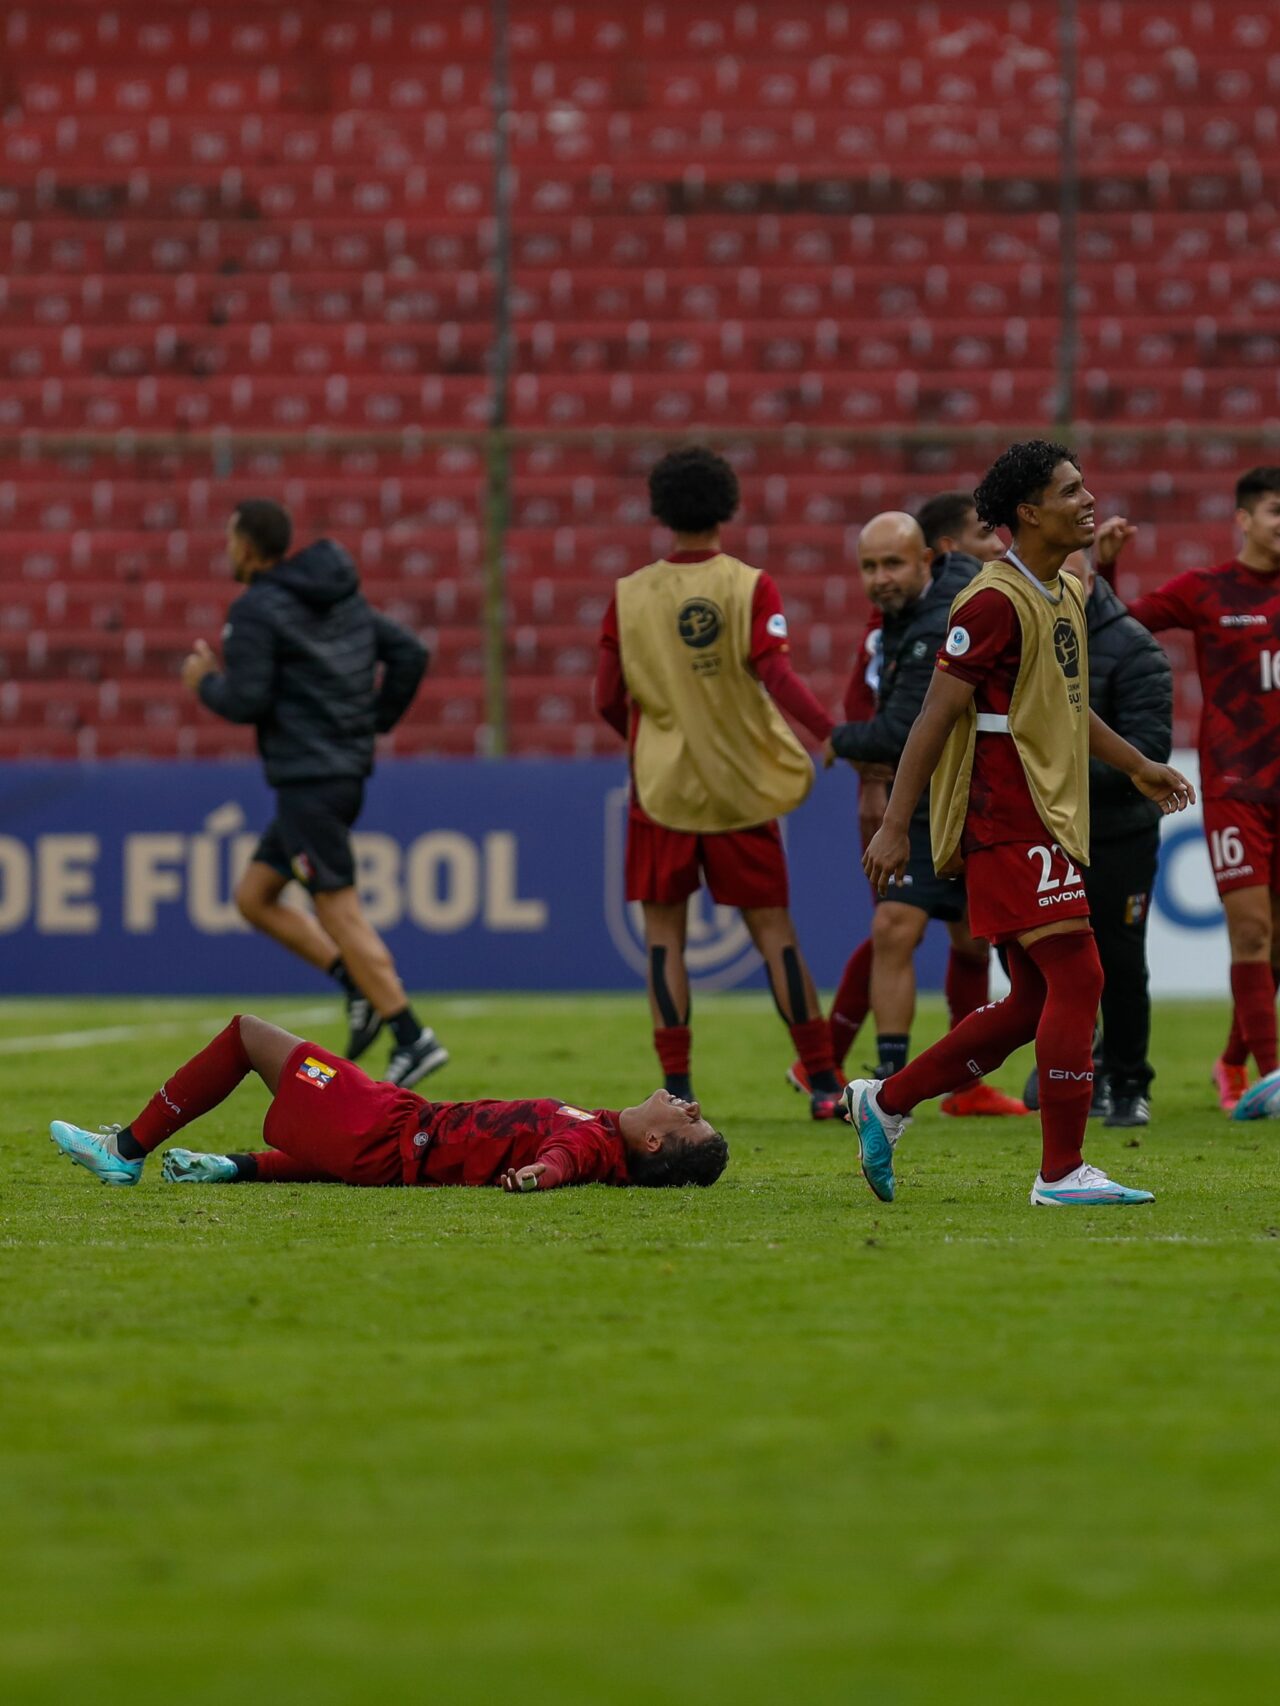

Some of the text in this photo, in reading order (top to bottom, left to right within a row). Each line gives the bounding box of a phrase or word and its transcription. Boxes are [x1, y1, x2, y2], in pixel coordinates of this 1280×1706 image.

[123, 799, 548, 936] FÚBOL
[1027, 843, 1082, 893] 22
[1210, 826, 1244, 869] 16
[1038, 889, 1087, 907] GIVOVA
[1048, 1068, 1095, 1082] GIVO
